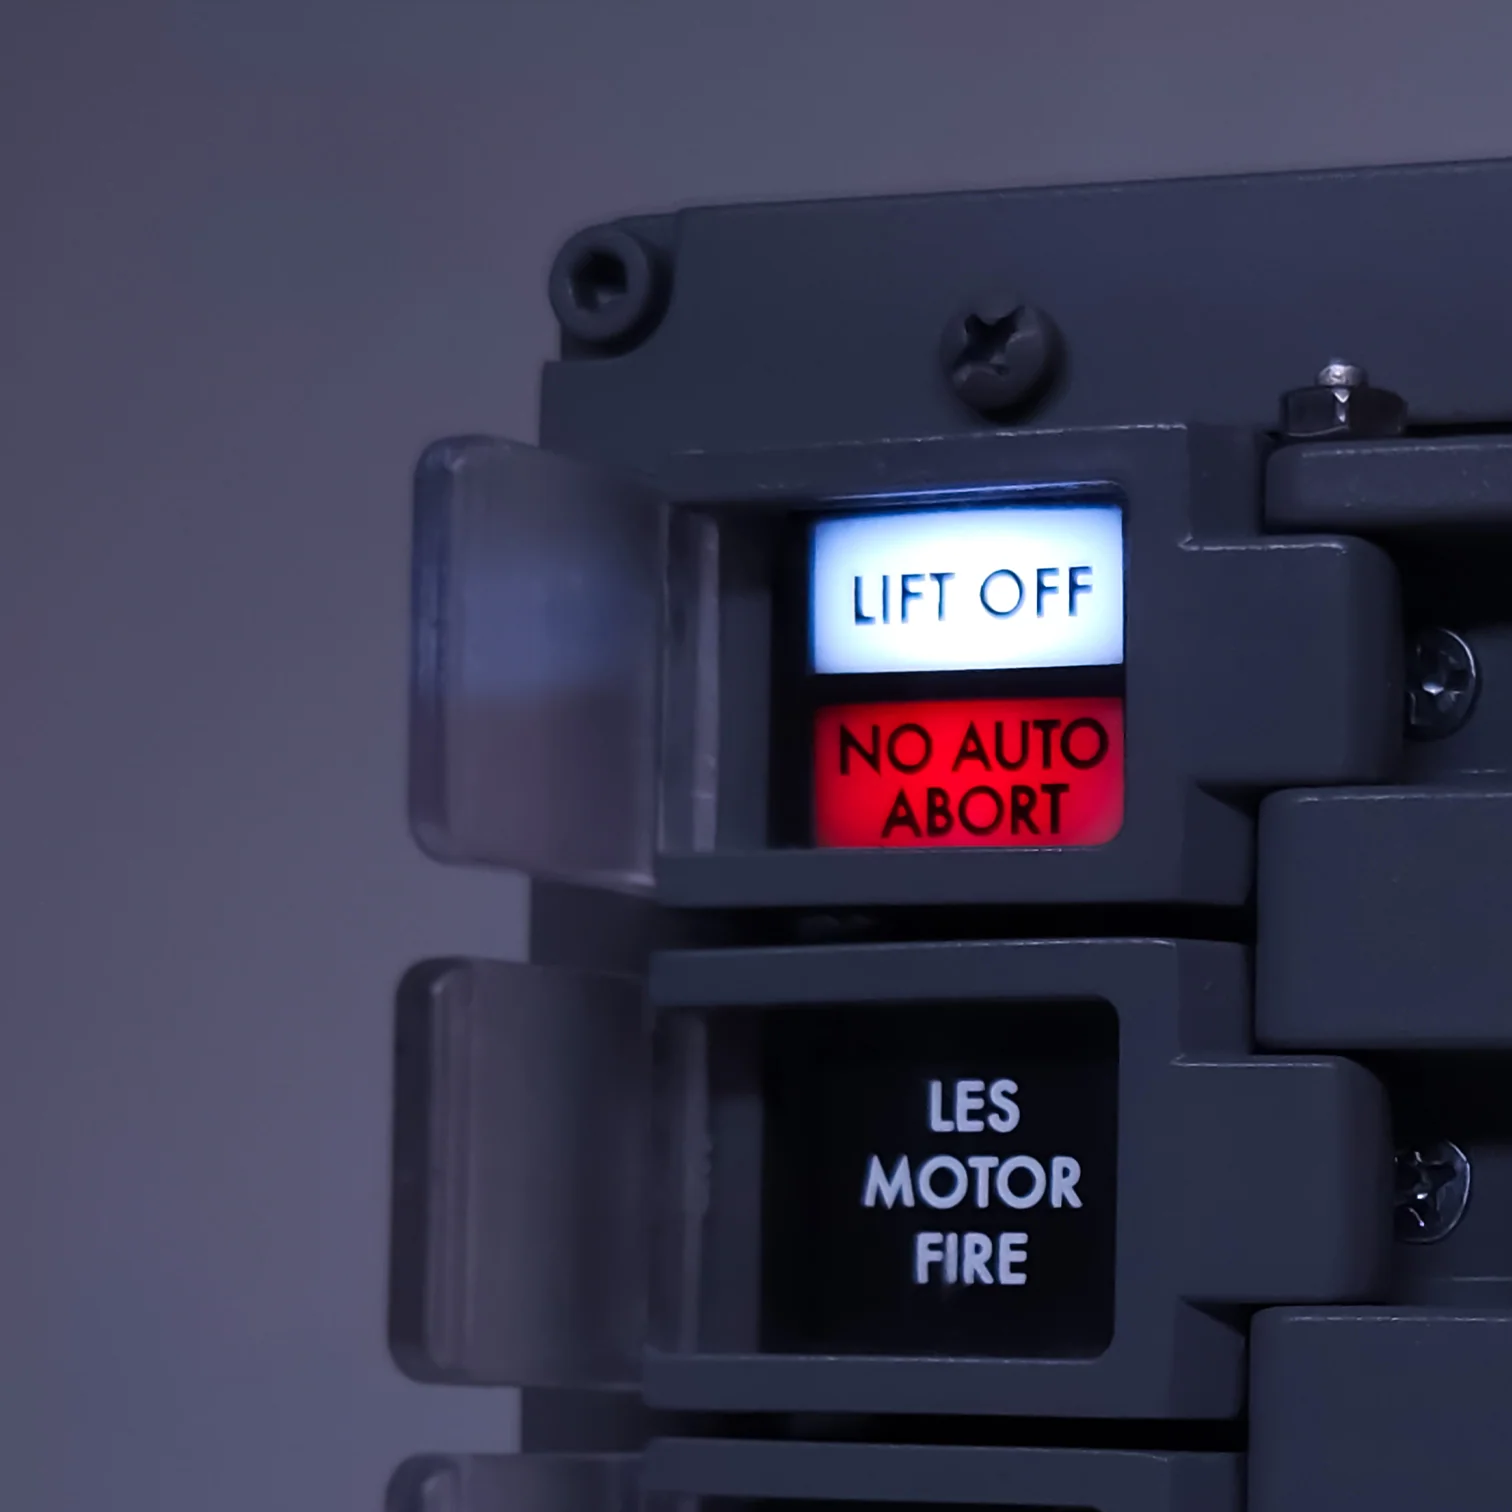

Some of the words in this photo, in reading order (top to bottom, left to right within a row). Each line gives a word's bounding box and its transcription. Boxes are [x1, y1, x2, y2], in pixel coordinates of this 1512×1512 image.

[852, 571, 954, 626] LIFT
[978, 565, 1092, 618] OFF
[838, 722, 933, 775] NO
[952, 715, 1111, 771] AUTO
[880, 782, 1070, 839] ABORT
[930, 1079, 1020, 1133] LES
[864, 1155, 1083, 1209] MOTOR
[916, 1232, 1029, 1285] FIRE
